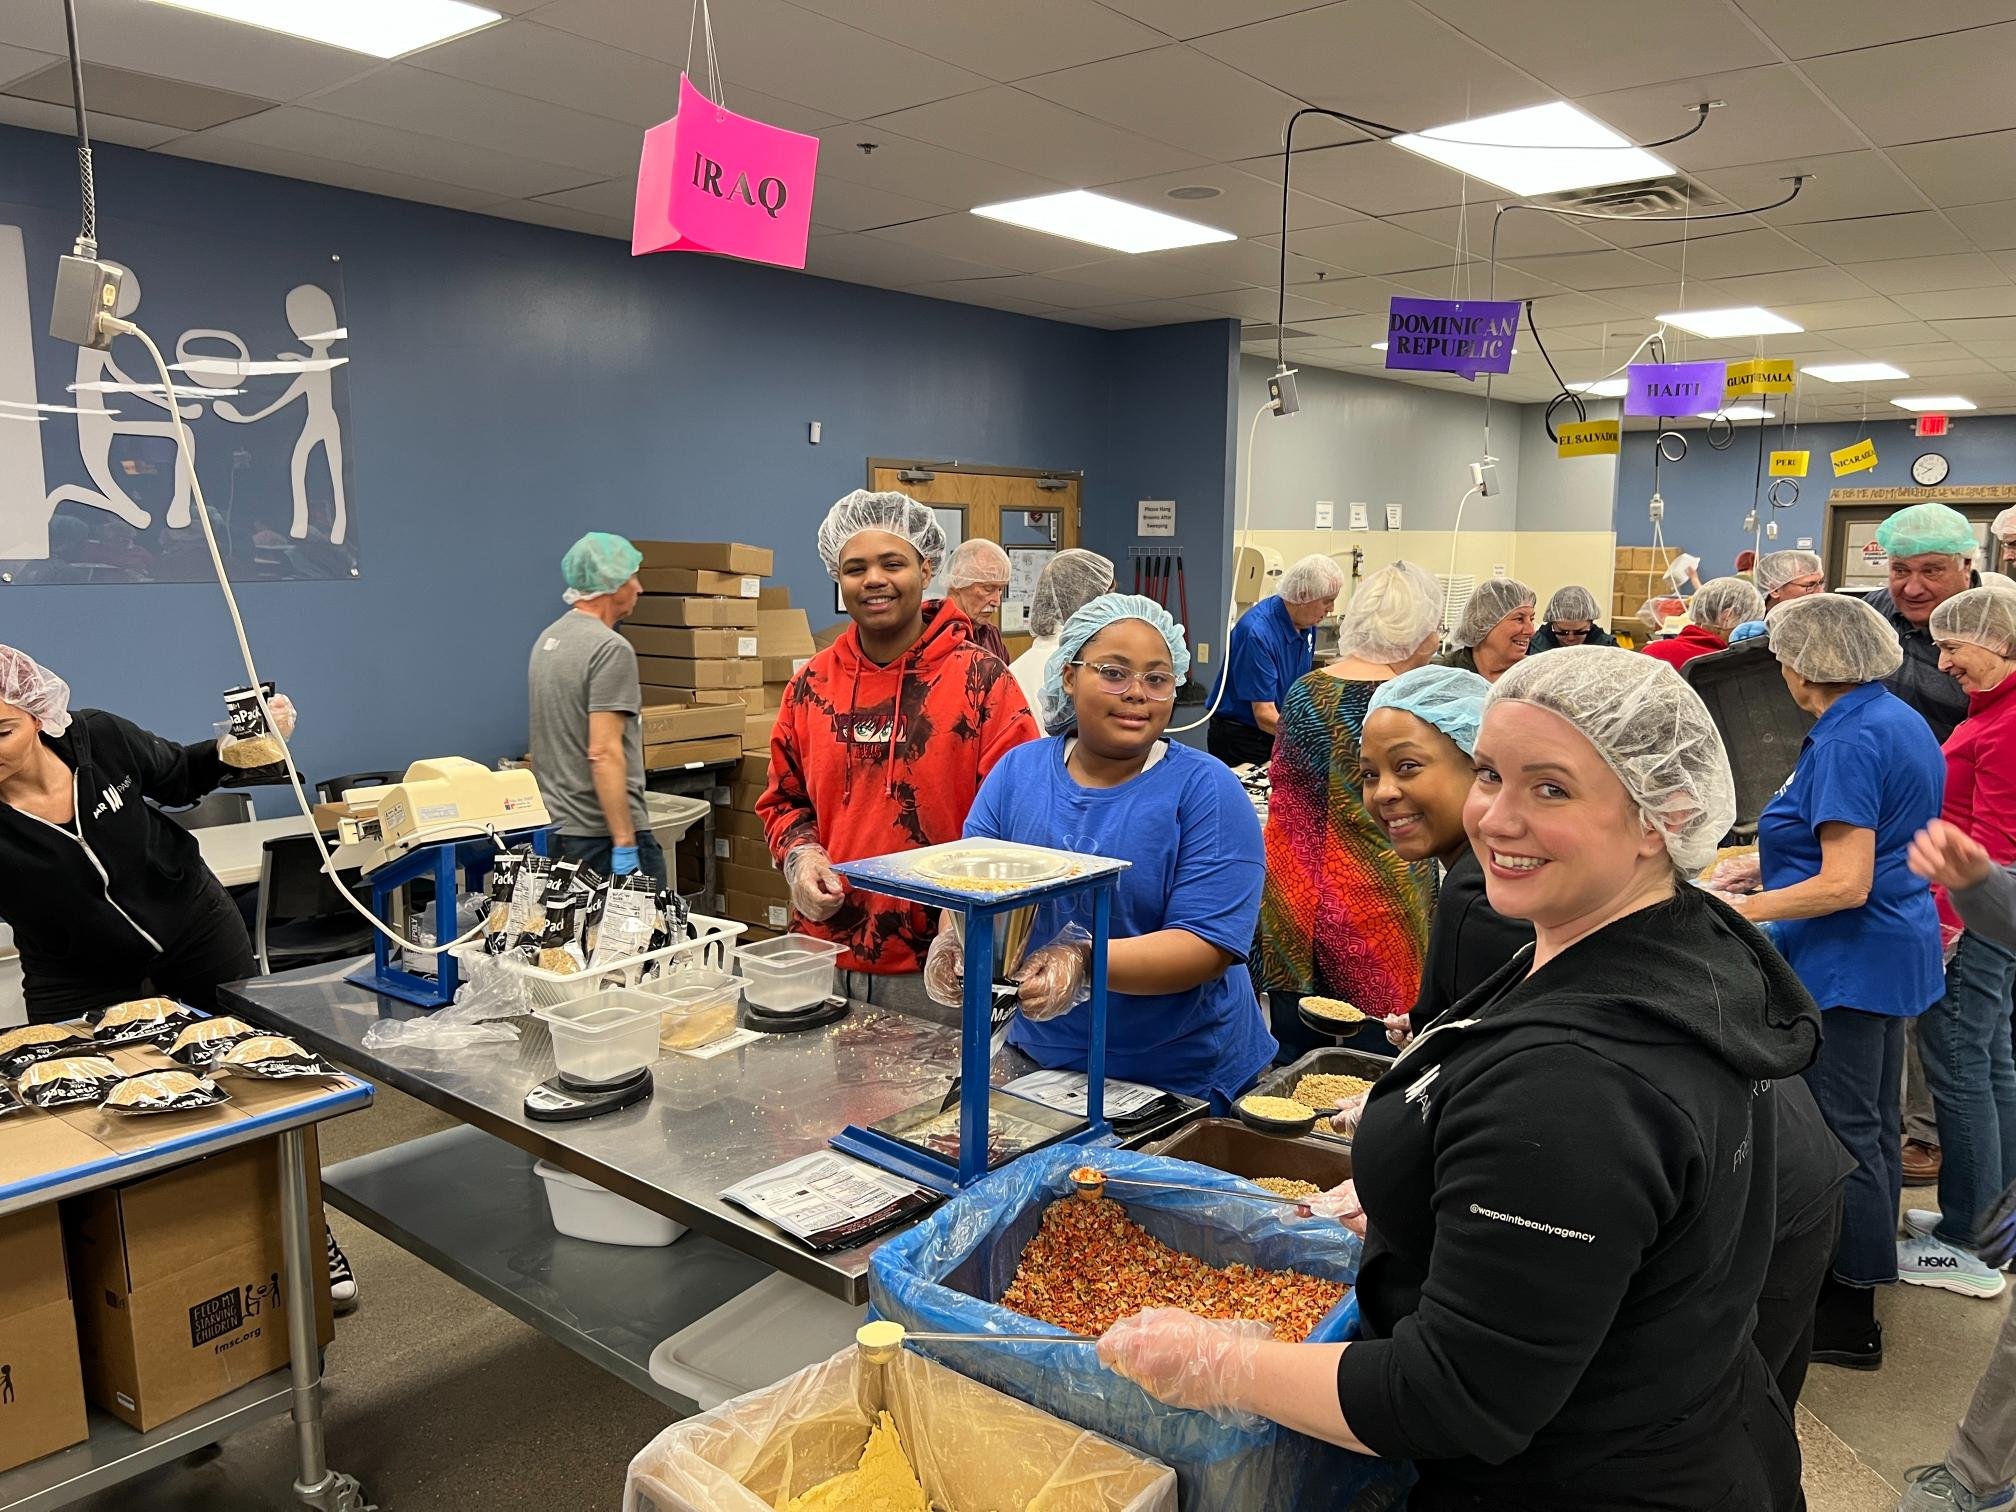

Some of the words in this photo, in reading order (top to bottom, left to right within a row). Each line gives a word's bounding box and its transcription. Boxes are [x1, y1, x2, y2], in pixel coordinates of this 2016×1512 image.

[691, 151, 787, 218] IRAQ
[1390, 313, 1514, 337] DOMINICAN
[1397, 336, 1503, 359] REPUBLIC
[1647, 383, 1702, 397] HAITI
[1559, 435, 1573, 445] EL
[1469, 1203, 1596, 1243] @warpaintbeautyagency
[1917, 1256, 1958, 1269] HOKA
[194, 1300, 219, 1321] FEED
[222, 1293, 236, 1307] MY
[195, 1305, 237, 1332] STARVING
[196, 1316, 238, 1343] CHILDREN
[214, 1327, 262, 1355] fmsc.org
